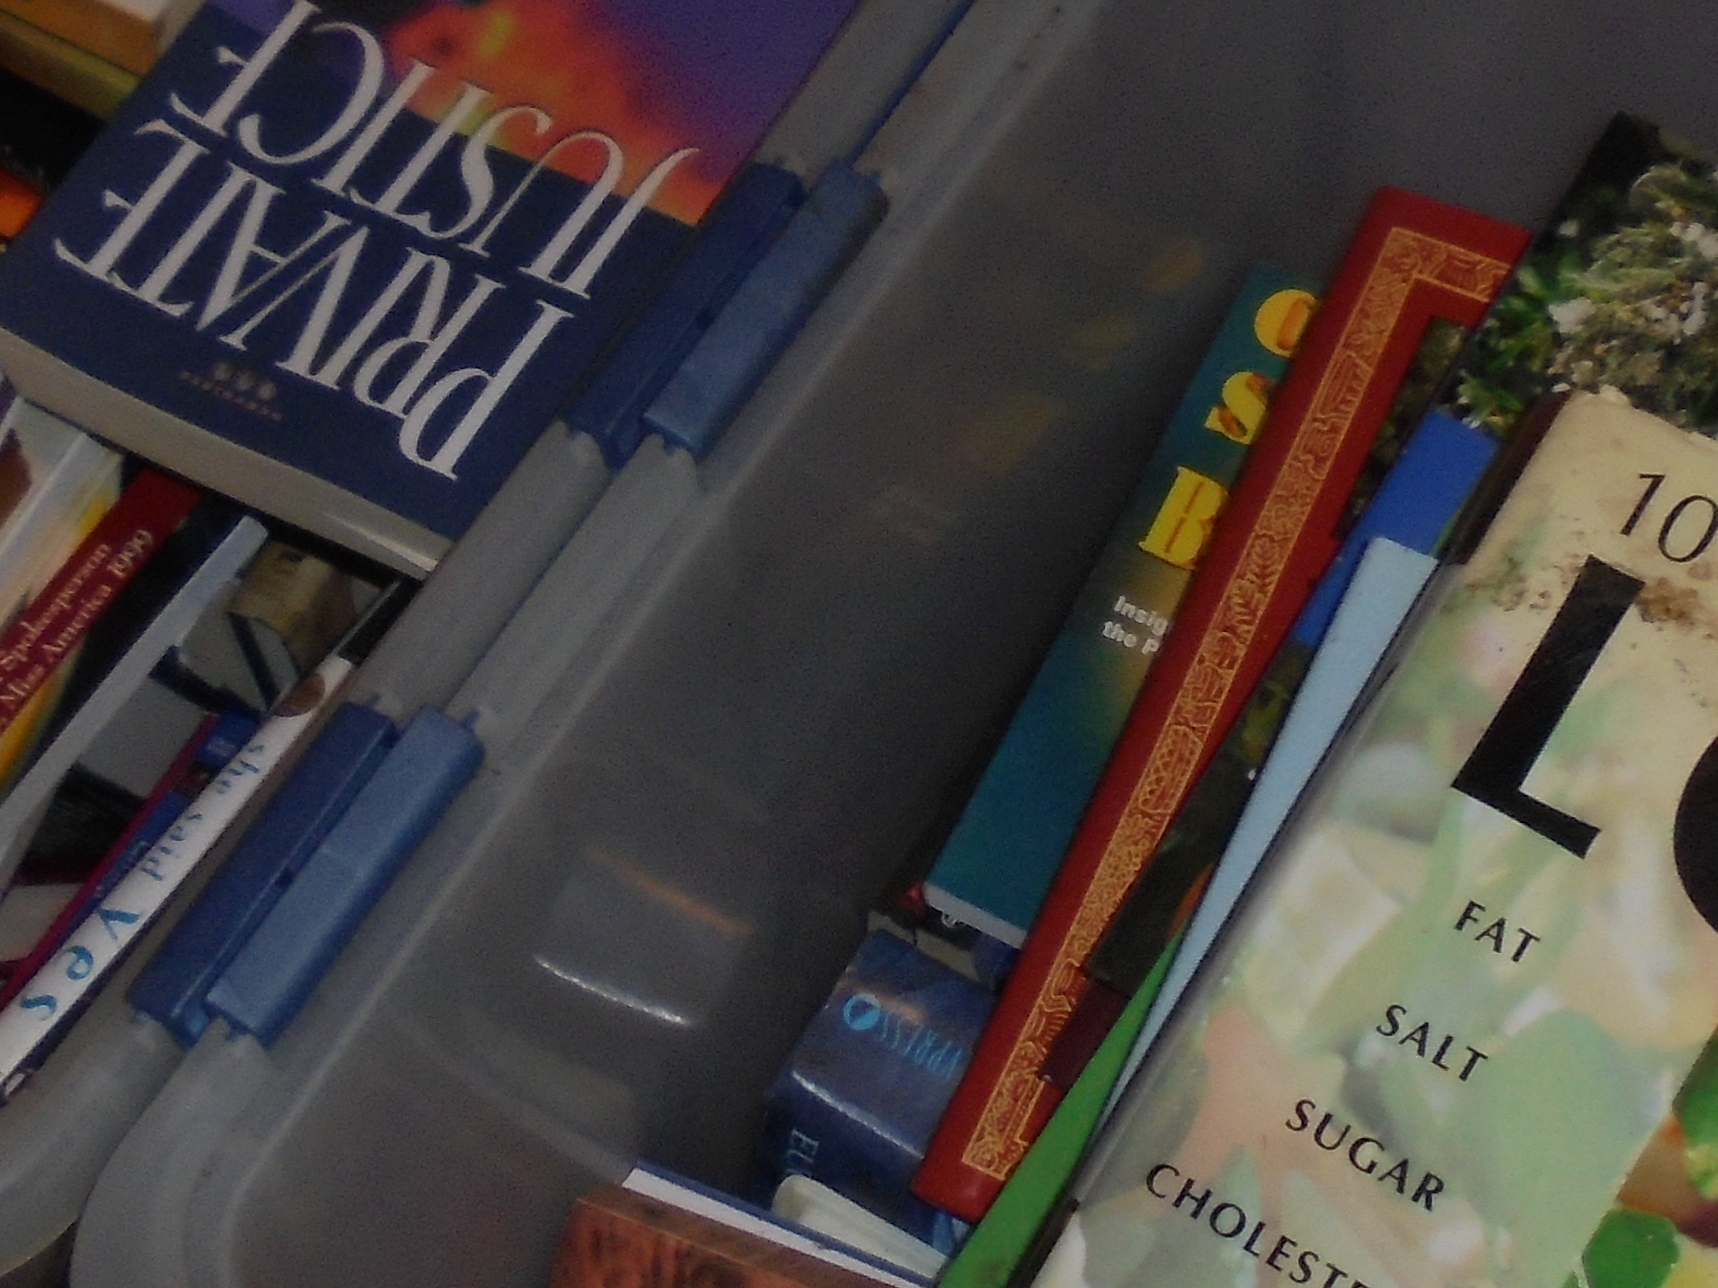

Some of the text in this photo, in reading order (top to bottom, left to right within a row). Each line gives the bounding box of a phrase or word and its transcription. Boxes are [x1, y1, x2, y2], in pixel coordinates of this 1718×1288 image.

[54, 117, 576, 481] PRIVATE
[41, 583, 113, 664] America
[106, 529, 155, 578] 1999
[1113, 594, 1169, 639] Insig
[1101, 620, 1139, 650] the
[216, 743, 265, 796] she
[139, 811, 204, 883] said
[1454, 900, 1540, 965] FAT
[1375, 1003, 1490, 1082] SALT
[1284, 1098, 1445, 1212] SUGAR
